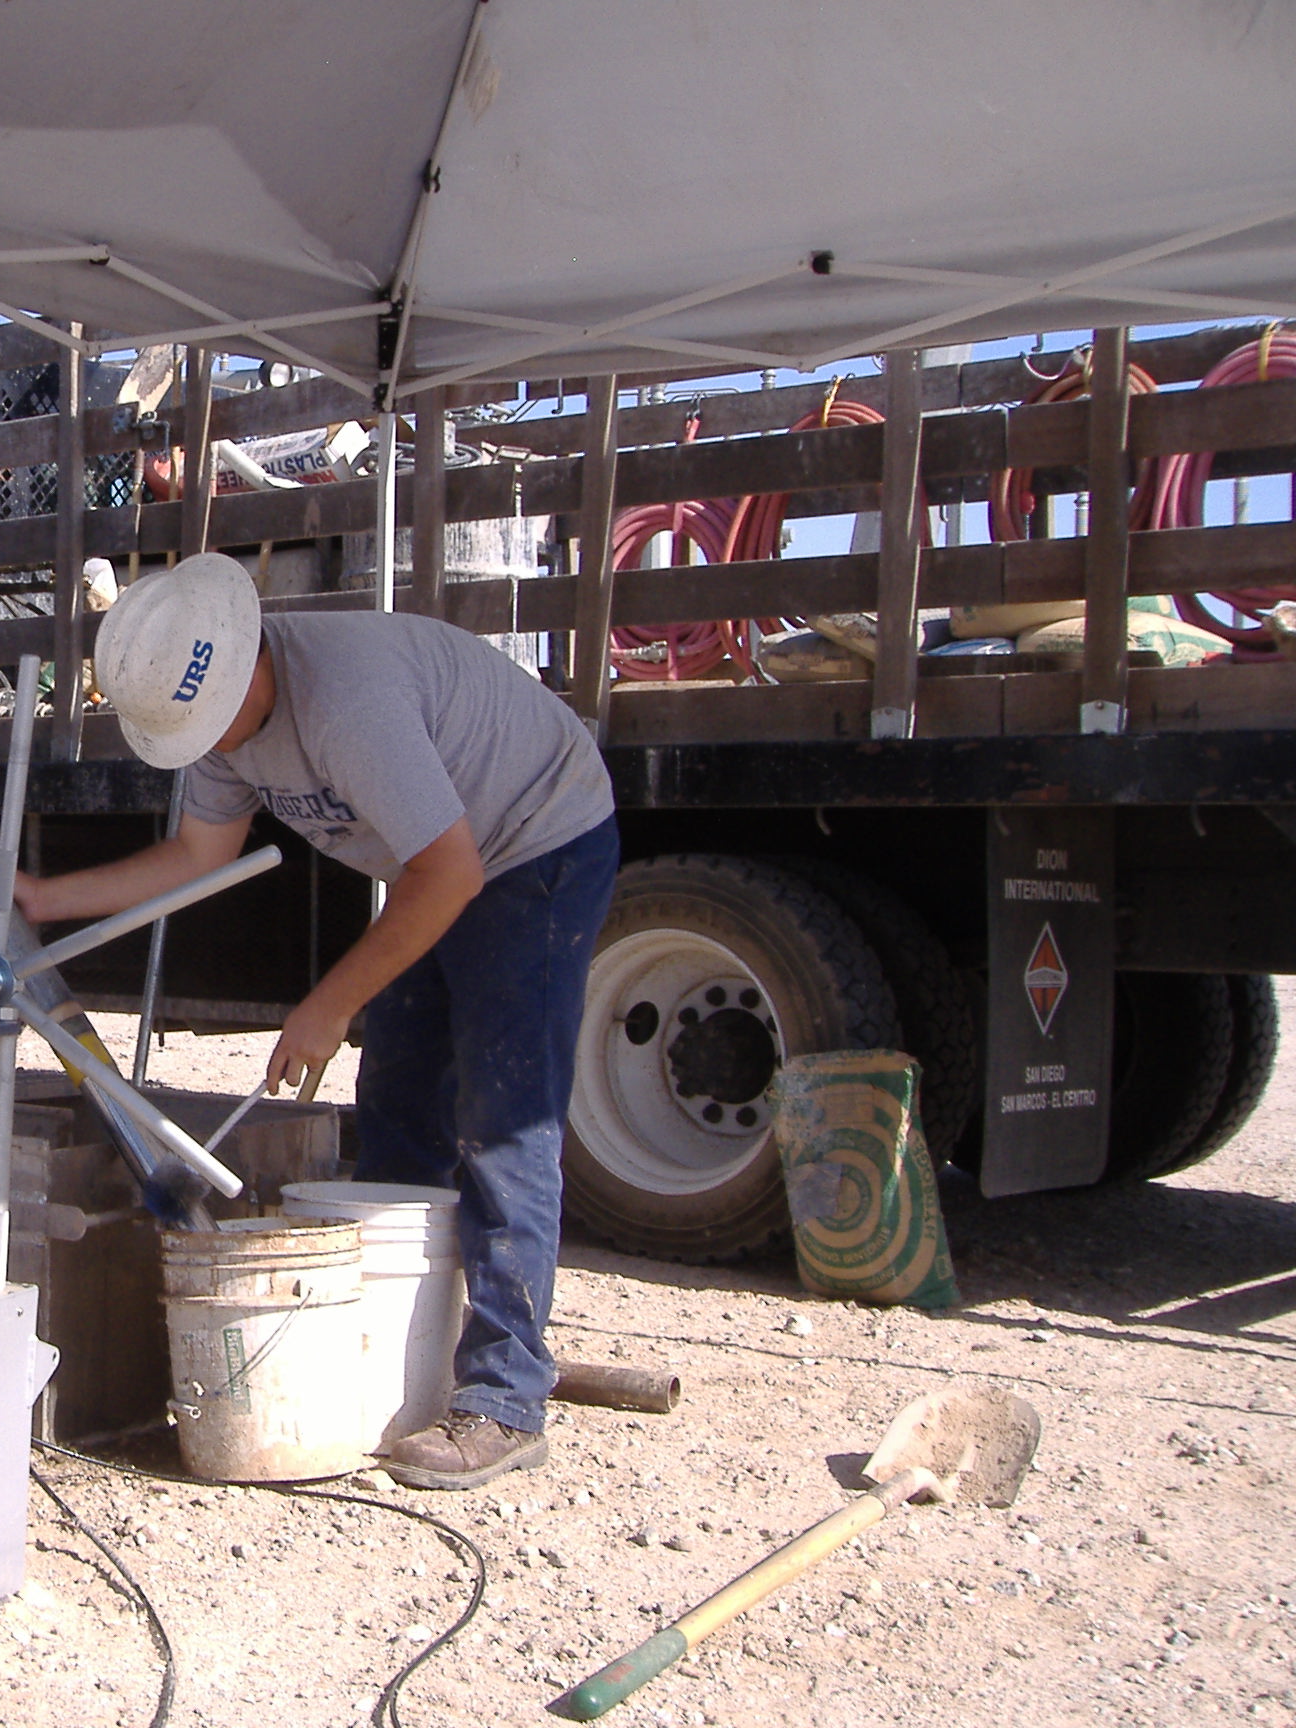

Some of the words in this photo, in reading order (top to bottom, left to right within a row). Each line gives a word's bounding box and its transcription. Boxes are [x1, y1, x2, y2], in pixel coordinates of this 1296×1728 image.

[172, 640, 213, 702] URS
[257, 786, 358, 822] DGERS
[1036, 848, 1068, 870] DION
[1004, 878, 1101, 903] INTERNATIONAL
[1025, 1066, 1041, 1084] SAN
[1042, 1064, 1066, 1082] DIEGO
[1001, 1095, 1015, 1114] SAN
[1016, 1092, 1046, 1112] MARCOS
[1052, 1091, 1062, 1108] EL
[1063, 1089, 1097, 1108] CENTRO
